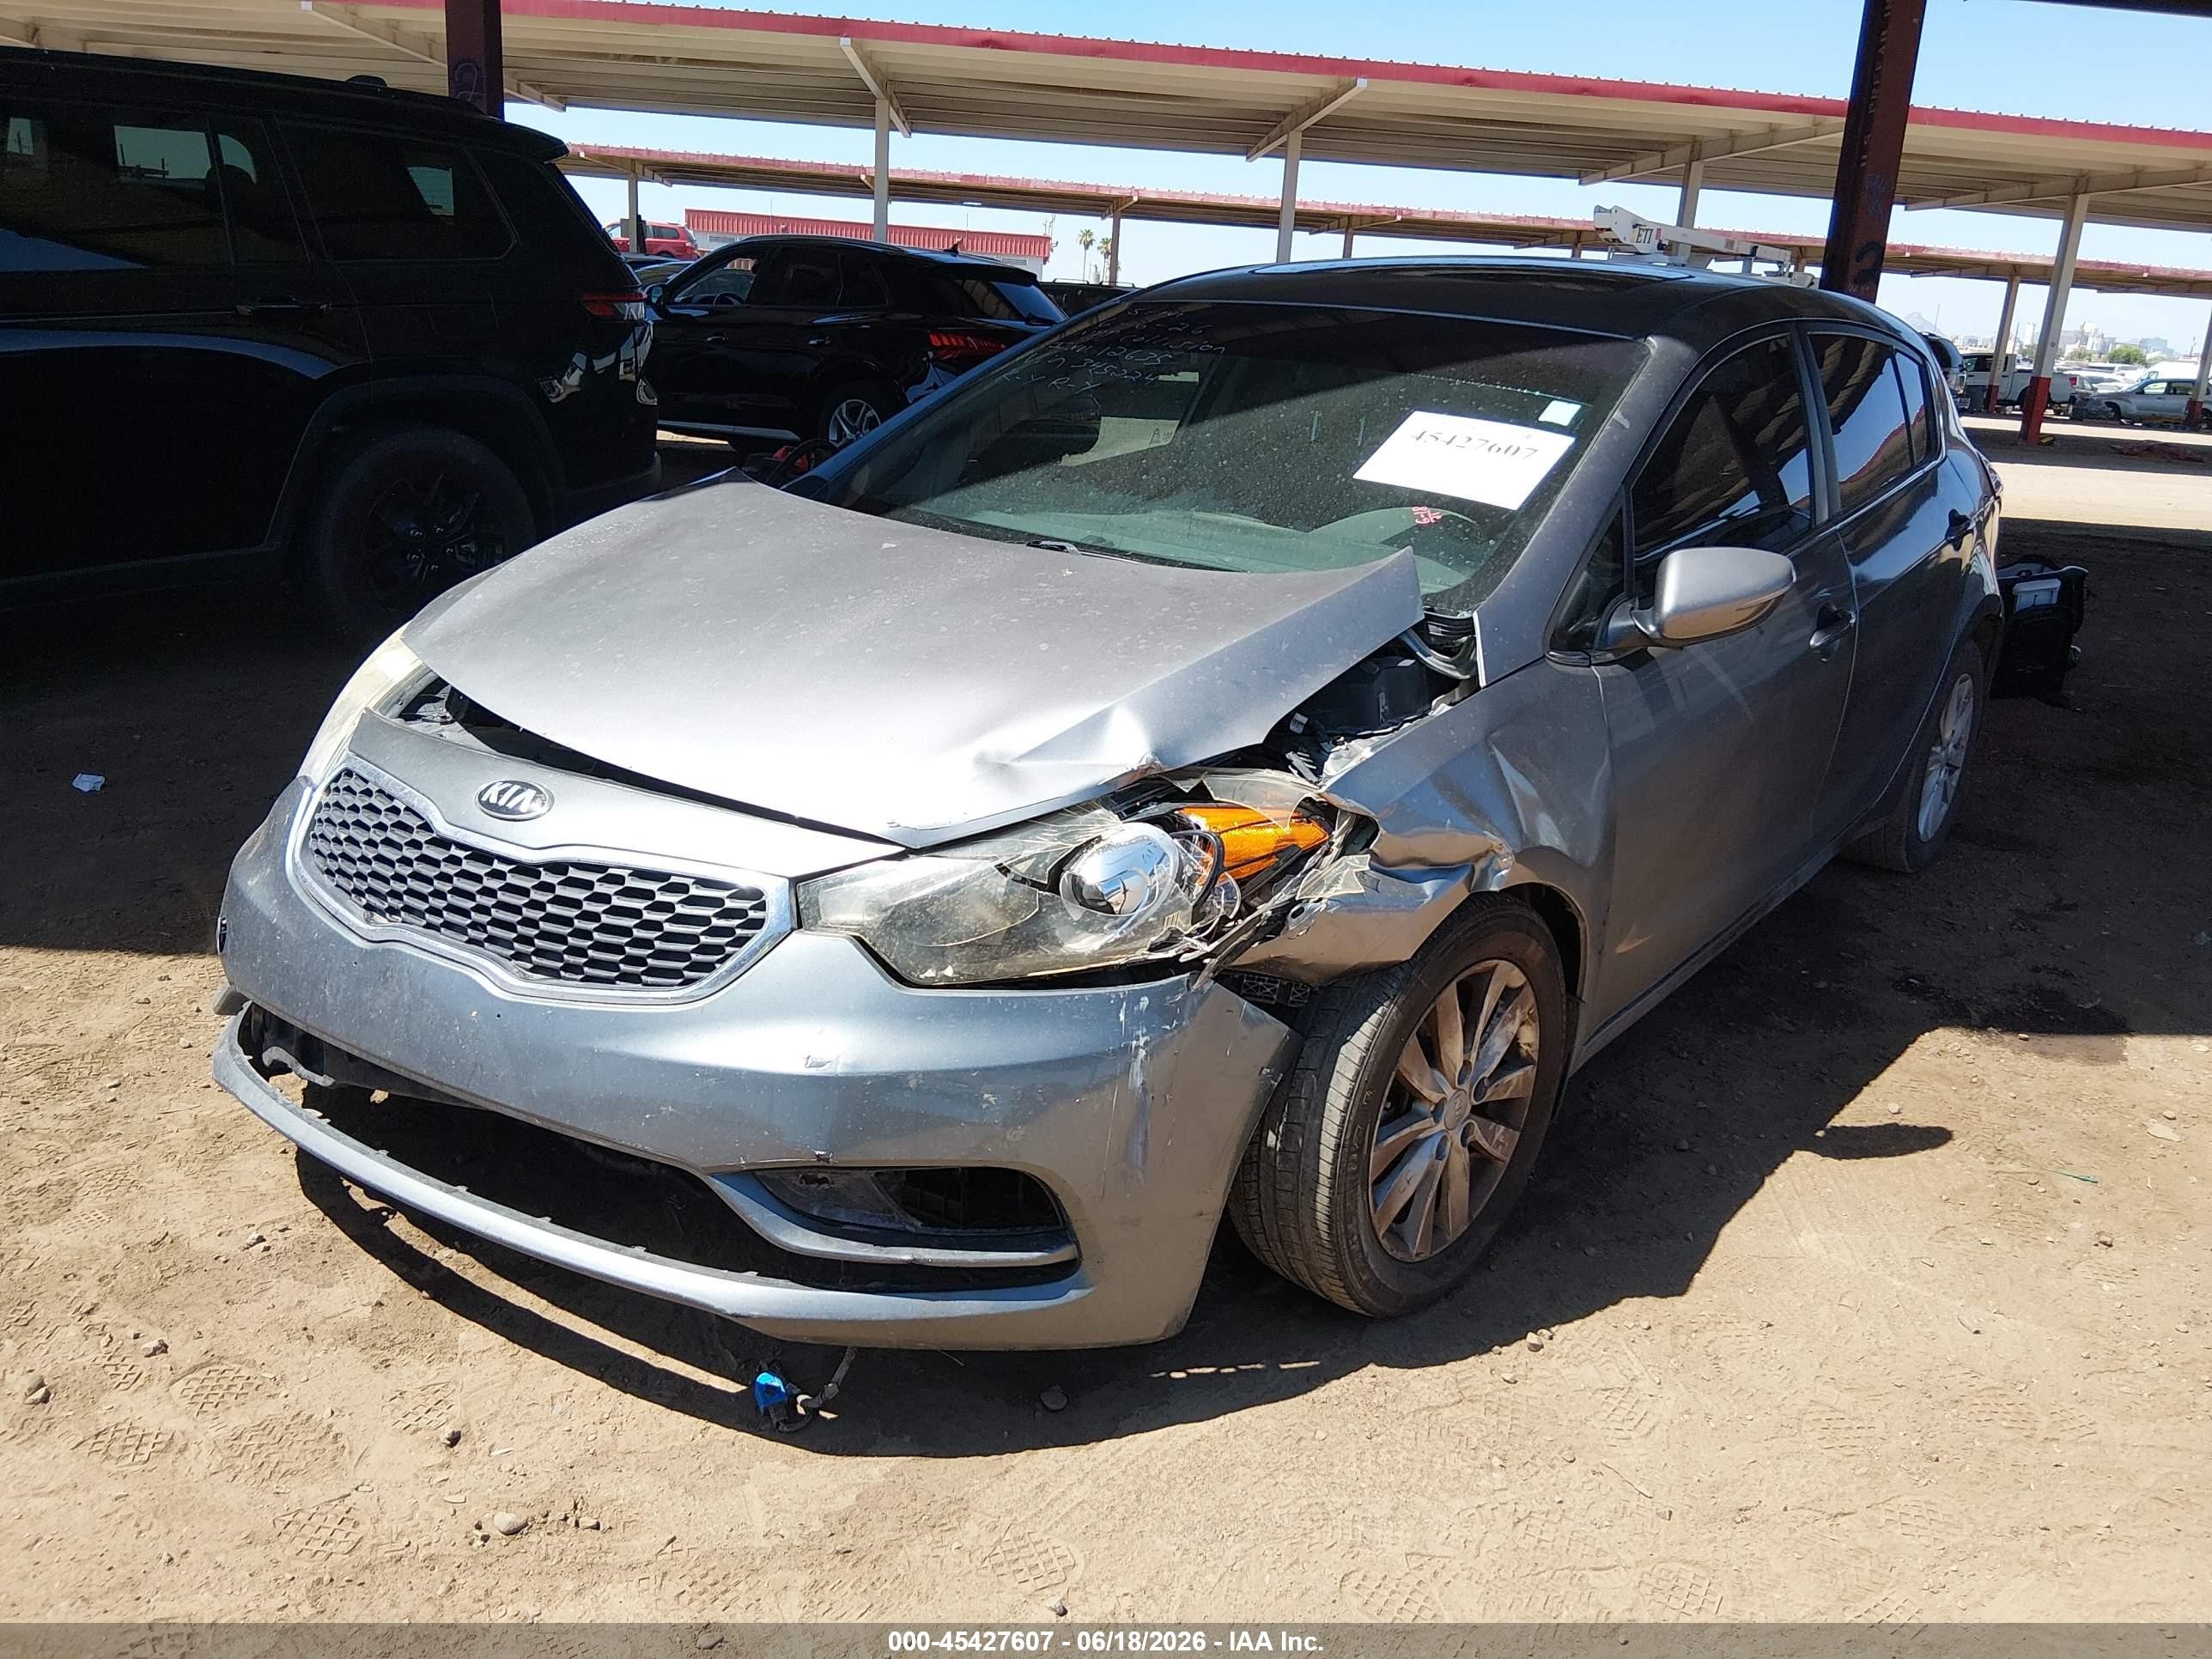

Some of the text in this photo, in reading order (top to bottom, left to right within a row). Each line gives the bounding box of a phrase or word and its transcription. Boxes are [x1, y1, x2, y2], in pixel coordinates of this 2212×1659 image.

[1096, 345, 1173, 366] 12635
[1409, 429, 1539, 460] 45427607
[480, 781, 537, 813] KIA
